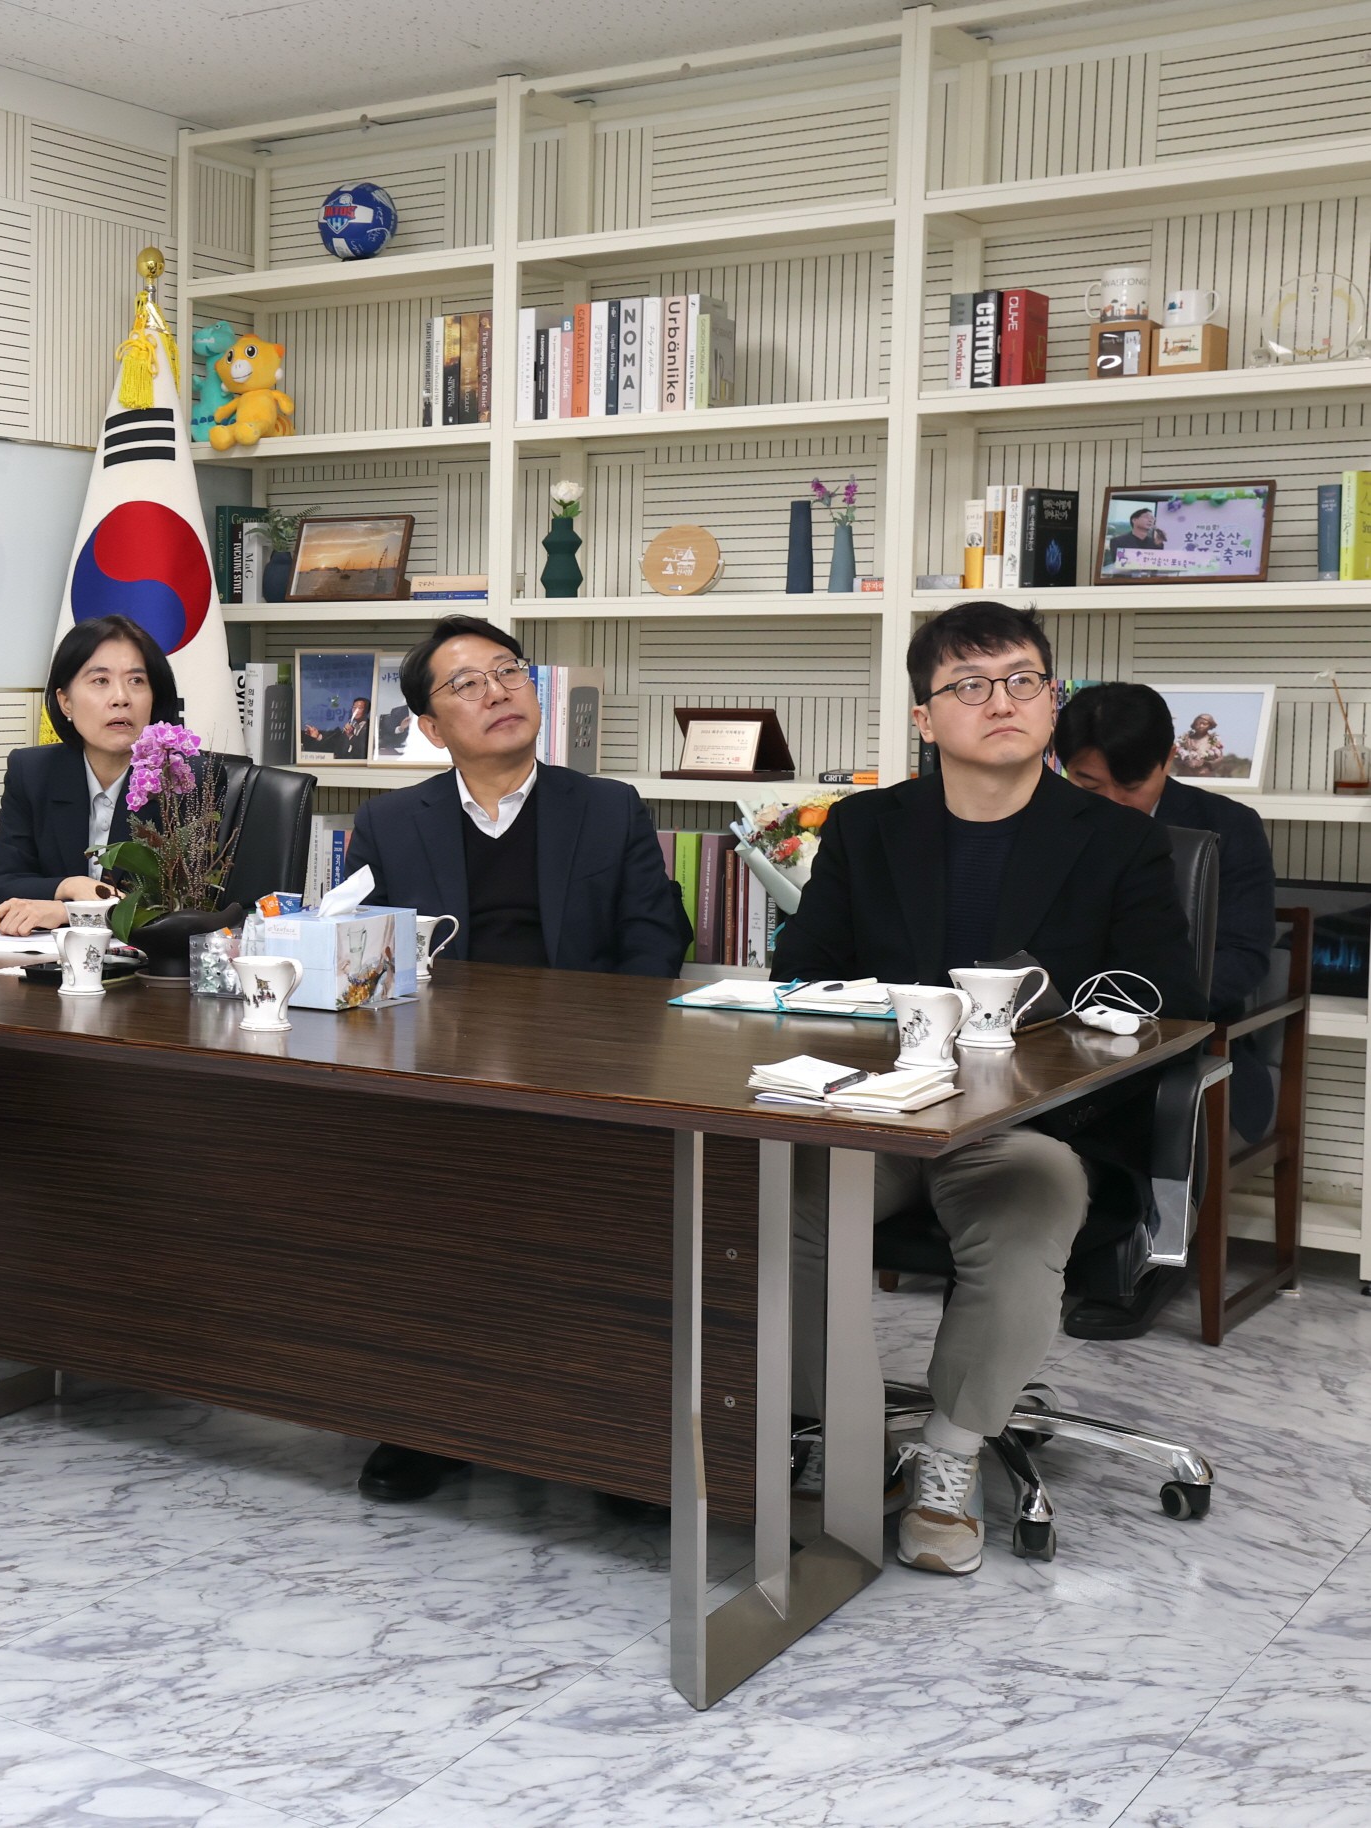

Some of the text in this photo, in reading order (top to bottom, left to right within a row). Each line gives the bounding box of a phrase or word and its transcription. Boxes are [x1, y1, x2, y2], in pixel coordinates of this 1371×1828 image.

[1101, 278, 1147, 288] WASEONG
[576, 309, 585, 384] CASTA LAETITIA
[623, 308, 637, 390] NOMA
[667, 302, 681, 404] Urbänlike
[974, 302, 995, 385] CENTURY
[563, 346, 571, 367] Acne
[955, 334, 967, 380] Revolution
[481, 374, 488, 383] Of
[1184, 532, 1241, 549] 화성송산
[233, 574, 241, 594] STYLE
[381, 672, 401, 684] 바꾸
[824, 774, 843, 782] GRIT
